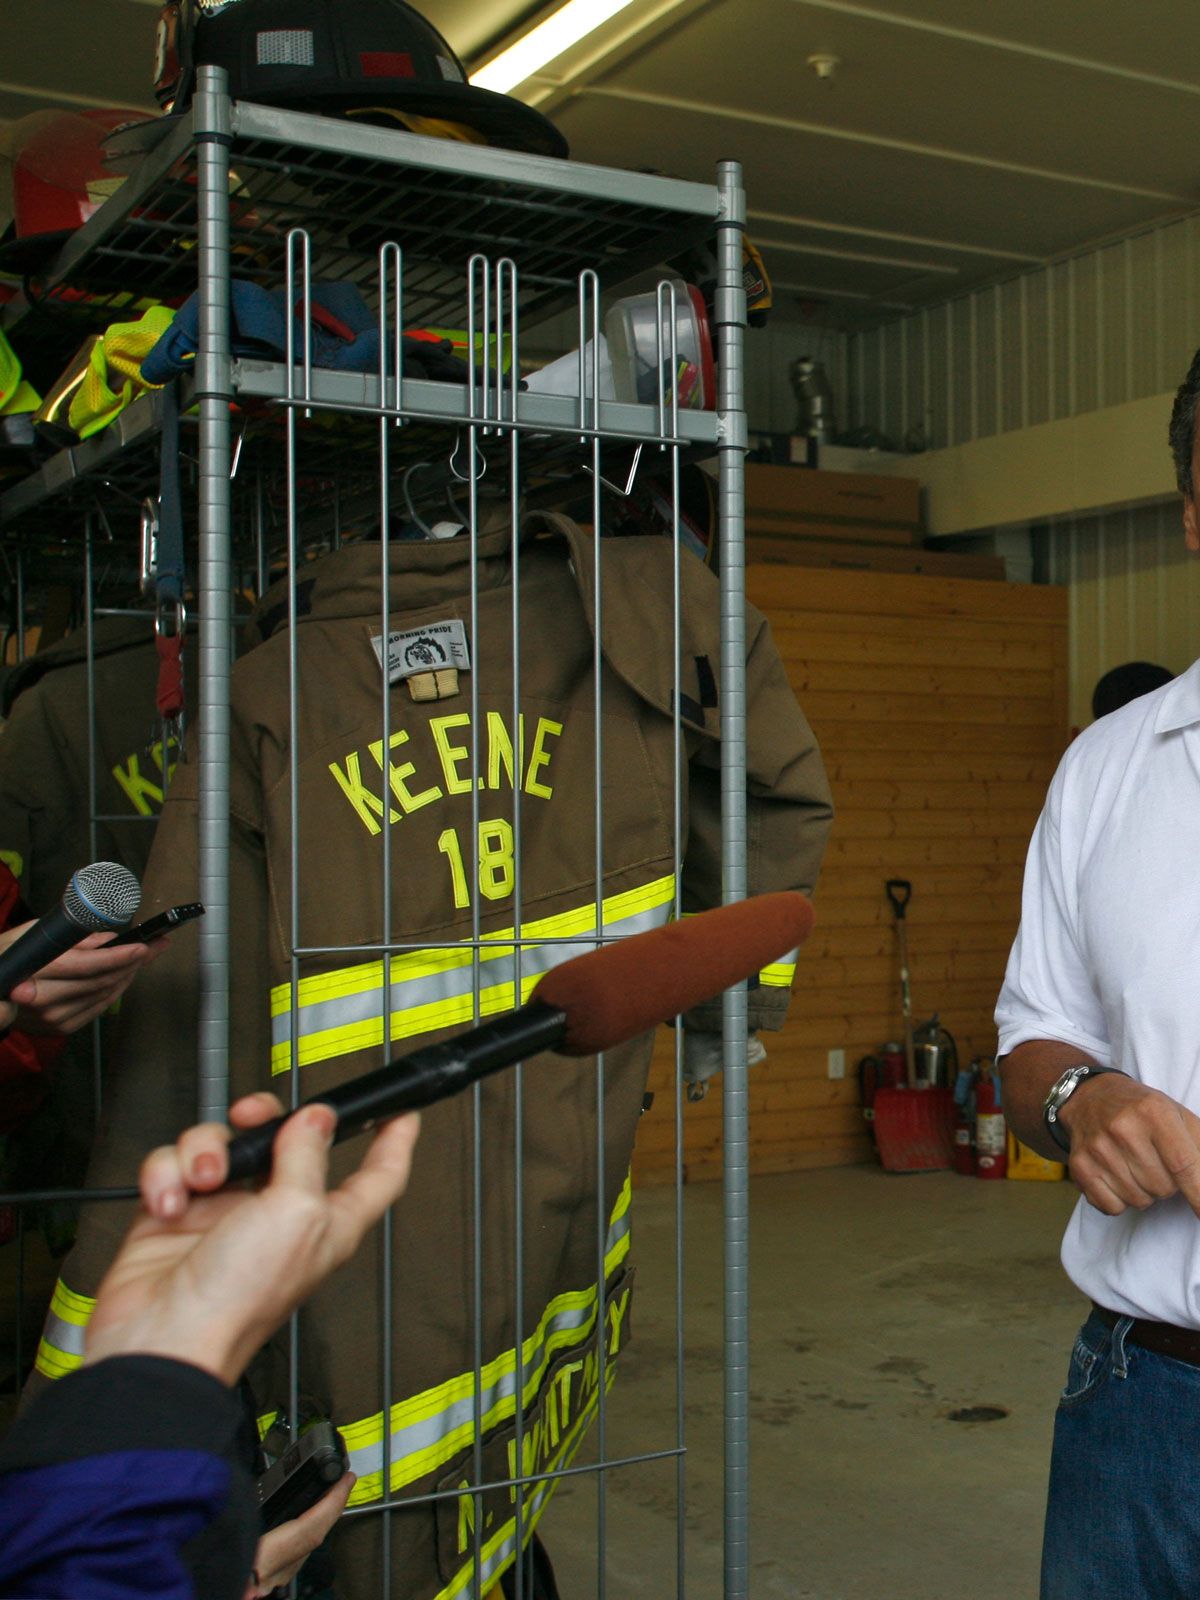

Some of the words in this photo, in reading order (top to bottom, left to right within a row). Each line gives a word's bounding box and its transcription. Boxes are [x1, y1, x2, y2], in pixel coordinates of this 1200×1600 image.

[428, 625, 453, 634] PRIDE
[328, 711, 563, 836] KEENE
[437, 818, 516, 908] 18
[507, 1288, 629, 1503] WHITNY
